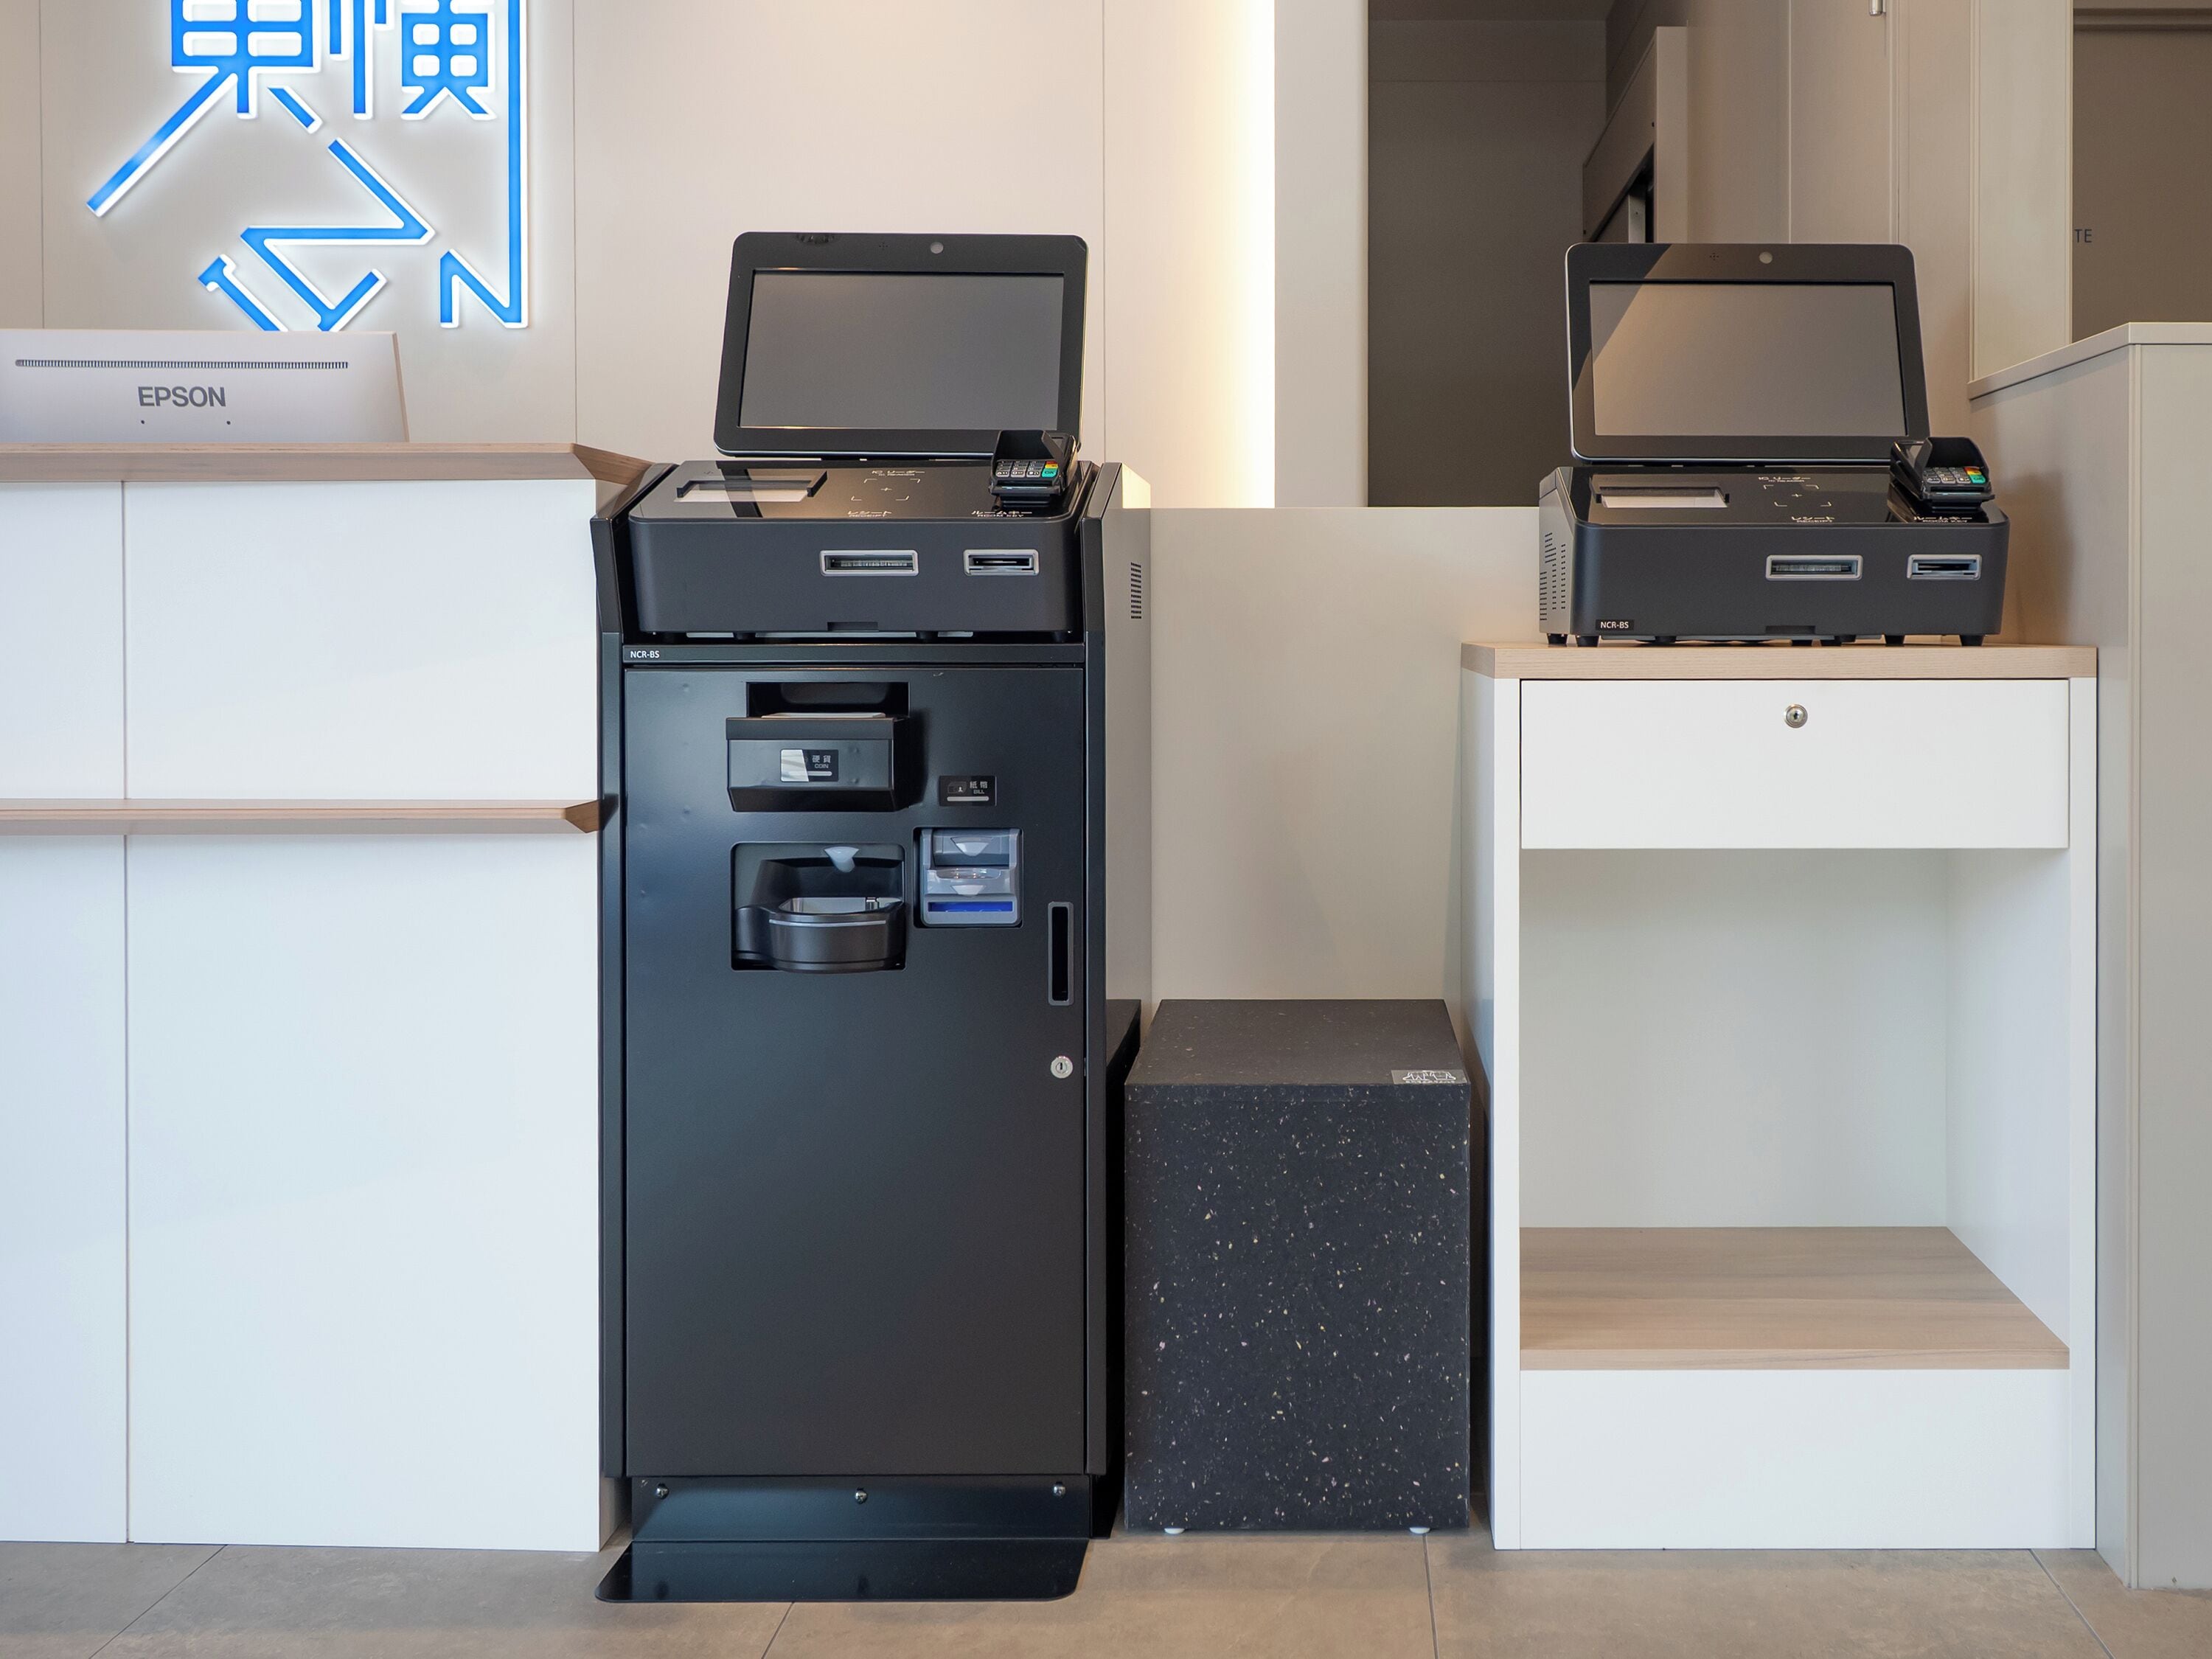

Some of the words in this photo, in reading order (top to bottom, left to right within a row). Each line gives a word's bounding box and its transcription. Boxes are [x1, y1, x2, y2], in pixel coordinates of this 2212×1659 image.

[138, 386, 226, 407] EPSON
[1600, 621, 1630, 629] NCR-BS
[630, 650, 660, 658] NCR-BS
